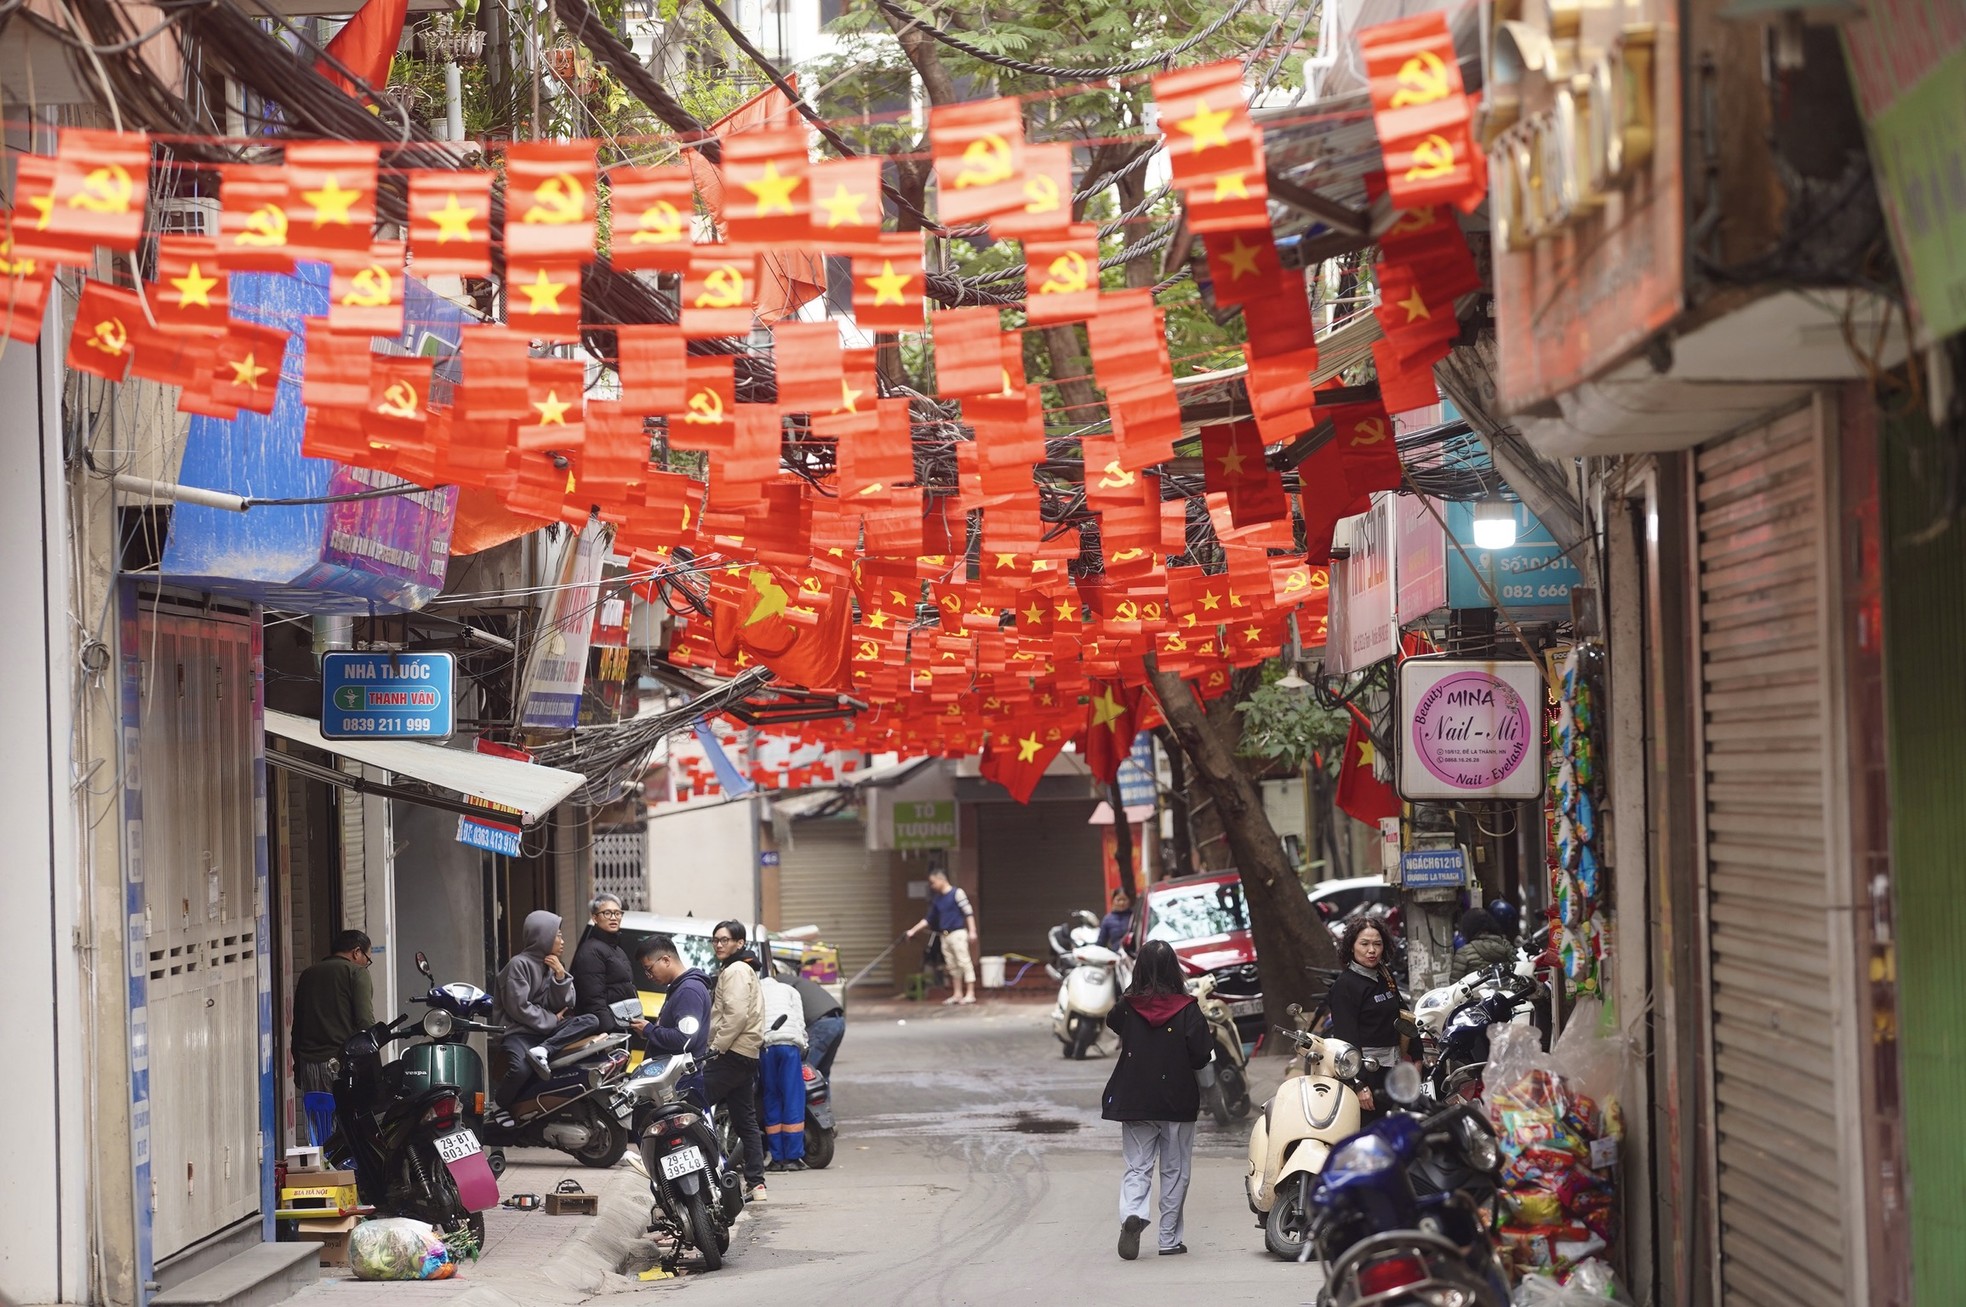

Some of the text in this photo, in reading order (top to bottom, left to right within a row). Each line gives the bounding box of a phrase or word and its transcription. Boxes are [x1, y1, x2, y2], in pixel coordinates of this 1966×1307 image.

[1503, 585, 1533, 598] 082
[1538, 584, 1568, 597] 666
[1553, 651, 1568, 659] POC
[344, 661, 376, 679] NHÀ
[369, 690, 435, 705] THANH VÂN
[1415, 686, 1443, 725] Beauty
[1447, 689, 1495, 708] MINA
[343, 718, 430, 731] 0839 211 999
[1425, 715, 1474, 741] Nail
[1486, 715, 1519, 741] Mi
[1456, 773, 1482, 785] Nail
[1491, 741, 1523, 779] Eyelash
[490, 831, 502, 850] 413
[441, 1133, 470, 1149] 29-B1
[444, 1142, 479, 1160] 903.14
[667, 1149, 695, 1166] 29-E1
[667, 1159, 701, 1177] 395.48
